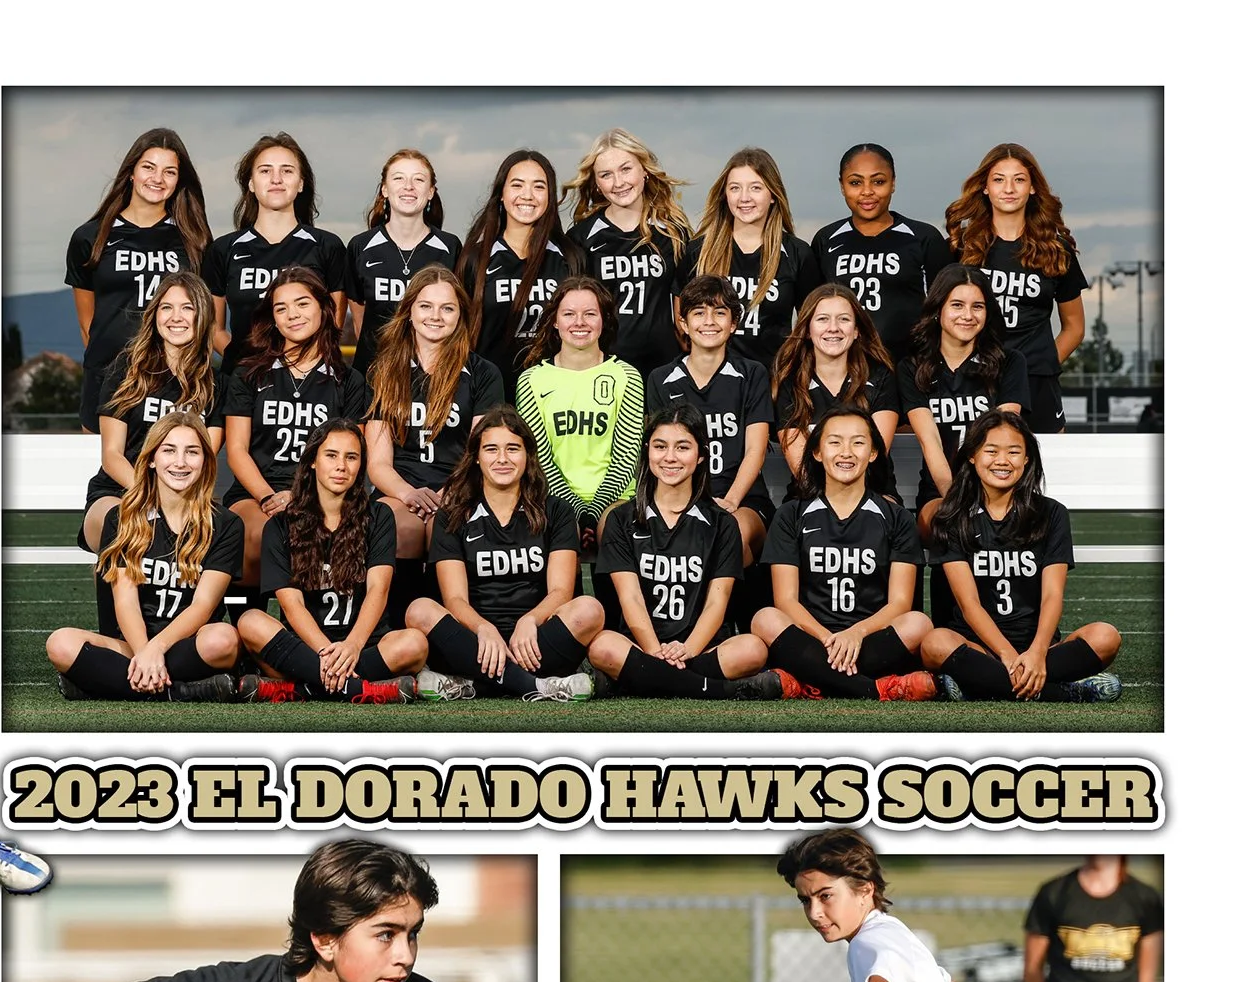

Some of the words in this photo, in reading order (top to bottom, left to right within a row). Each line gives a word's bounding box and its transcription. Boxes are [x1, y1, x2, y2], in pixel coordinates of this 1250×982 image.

[115, 249, 180, 273] EDHS
[601, 253, 664, 280] EDHS
[836, 252, 900, 277] EDHS
[239, 267, 279, 290] ED
[374, 277, 411, 302] ED
[727, 276, 780, 302] DHS
[618, 280, 646, 315] 21
[850, 276, 882, 312] 23
[593, 374, 616, 406] 0
[262, 400, 328, 428] EDHS
[553, 409, 609, 437] EDHS
[929, 395, 989, 424] EDHS
[705, 412, 739, 439] HS
[274, 427, 309, 463] 25
[419, 429, 435, 464] 5
[708, 440, 724, 475] 8
[476, 545, 545, 577] EDHS
[639, 552, 704, 583] EDHS
[808, 546, 877, 576] EDHS
[972, 549, 1038, 578] EDHS
[155, 588, 183, 619] 17
[652, 583, 686, 621] 26
[826, 576, 856, 613] 16
[995, 579, 1014, 616] 3
